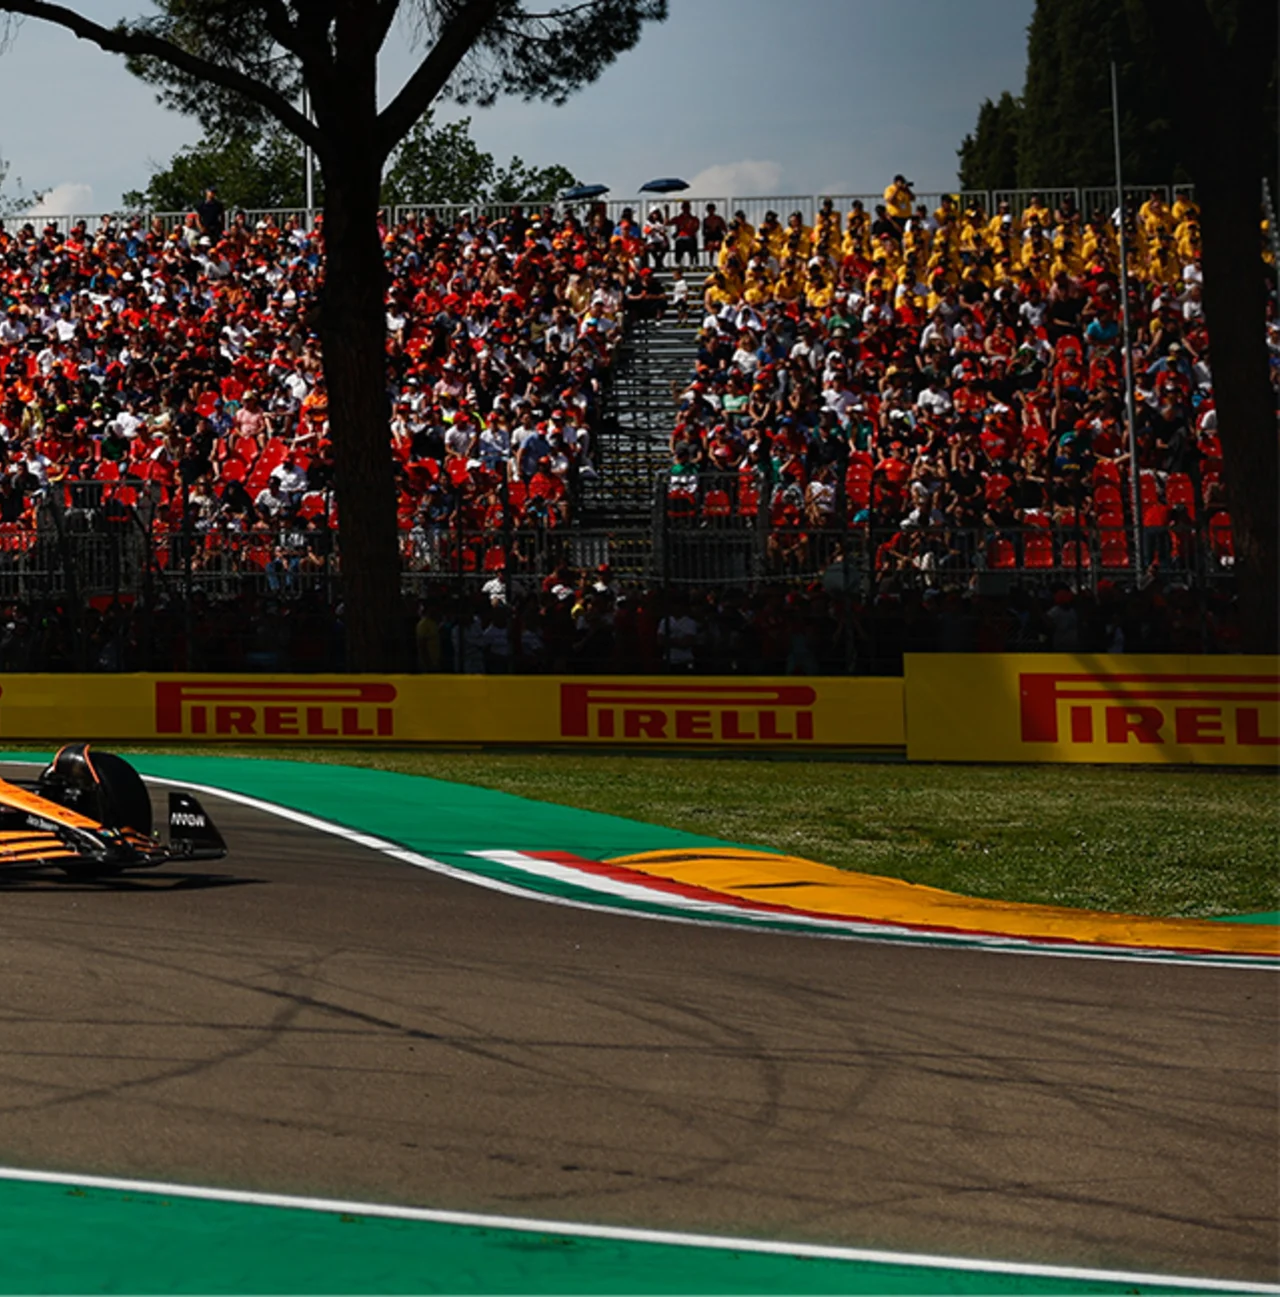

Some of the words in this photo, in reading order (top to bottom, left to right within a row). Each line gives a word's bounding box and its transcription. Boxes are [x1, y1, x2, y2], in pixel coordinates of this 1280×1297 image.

[156, 681, 397, 736] PIRELLI
[560, 683, 817, 740] PIRELLI
[1019, 673, 1280, 746] PIREL
